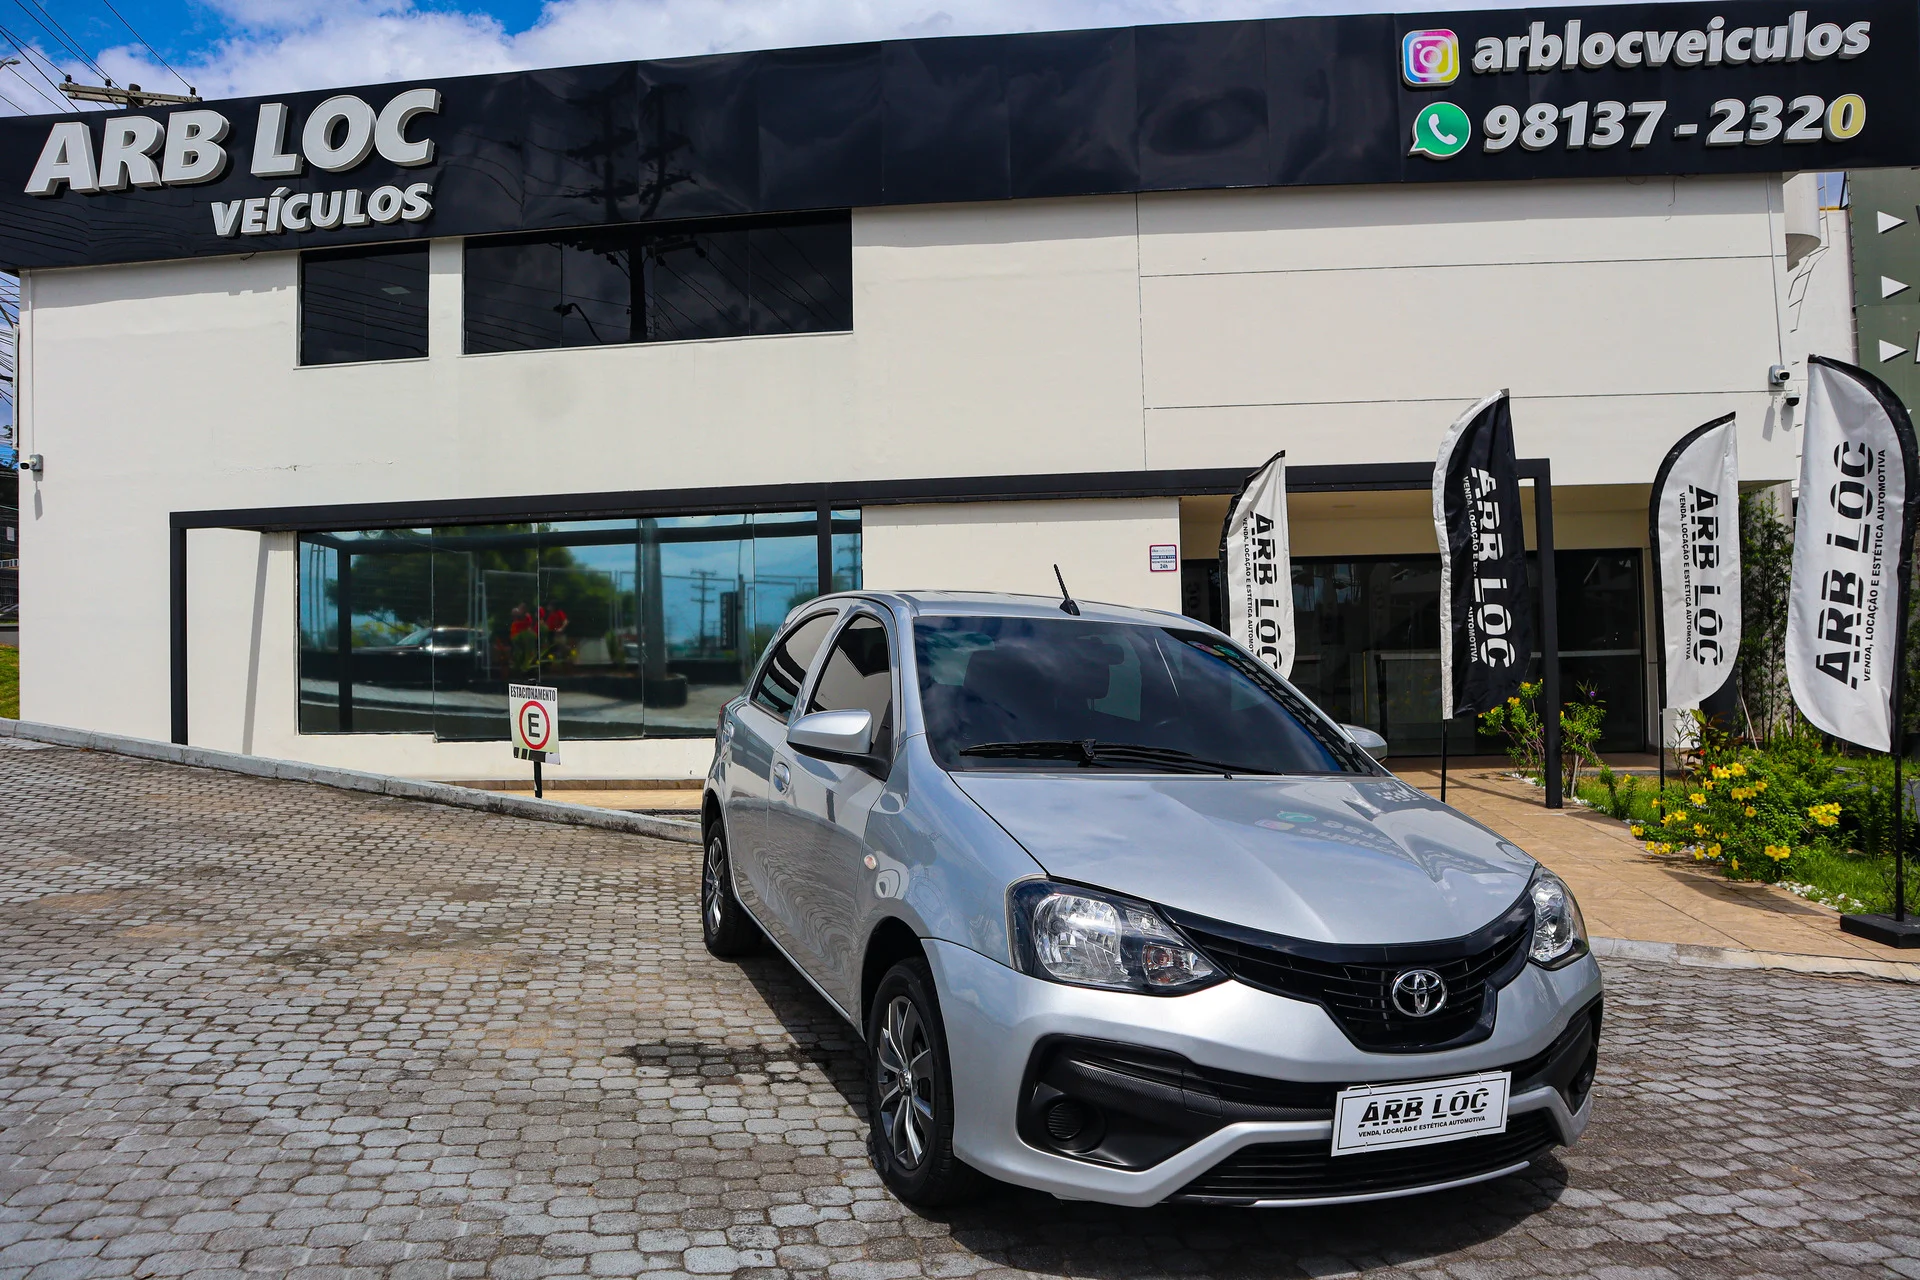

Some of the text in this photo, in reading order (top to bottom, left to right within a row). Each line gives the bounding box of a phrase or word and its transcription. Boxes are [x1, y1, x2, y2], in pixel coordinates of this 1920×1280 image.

[1472, 10, 1871, 74] arblocveiculos
[24, 88, 442, 197] ARB LOC
[211, 182, 434, 238] VEÍCULOS
[1679, 492, 1687, 521] VENDA,
[1877, 449, 1886, 520] AUTOMOTIVA
[1463, 476, 1473, 508] VENDA,
[1468, 509, 1479, 551] LOCAÇÃO
[1244, 544, 1252, 576] LOCAÇÃO
[1250, 510, 1277, 585] ARB
[1471, 467, 1516, 667] ARB LOC
[1681, 523, 1690, 560] LOCAÇÃO
[1816, 441, 1874, 690] ARB LOC
[1872, 524, 1884, 576] ESTÉTICA
[1684, 570, 1692, 607] ESTÉTICA
[1689, 484, 1724, 666] ARB LOC
[1255, 598, 1282, 669] LOC
[1865, 590, 1879, 640] LOCAÇÃO
[1864, 643, 1874, 681] VENDA,
[510, 686, 556, 701] ESTACIONAMENTO
[528, 713, 540, 737] E
[1358, 1088, 1489, 1129] ARB LOC
[1358, 1130, 1381, 1138] VENDA,
[1383, 1126, 1413, 1134] LOCAÇÃO
[1418, 1122, 1448, 1130] ESTÉTICA
[1448, 1116, 1486, 1126] AUTOMOTIVA
